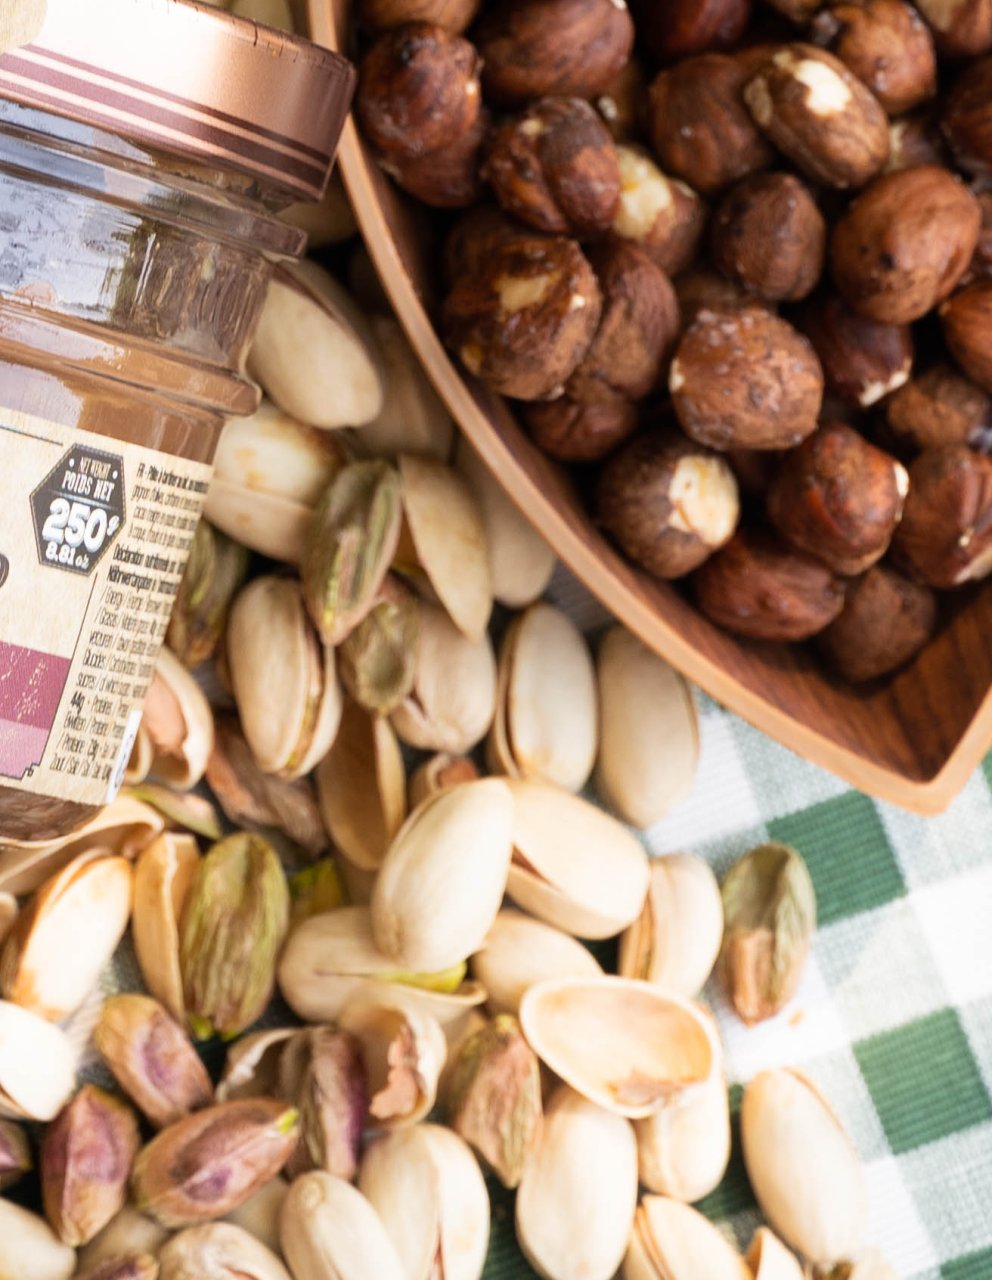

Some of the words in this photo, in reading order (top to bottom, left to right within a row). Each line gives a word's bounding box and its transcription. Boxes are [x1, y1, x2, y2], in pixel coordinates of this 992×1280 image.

[62, 470, 93, 495] POIDS
[93, 480, 115, 502] NET
[45, 541, 76, 566] 8.81
